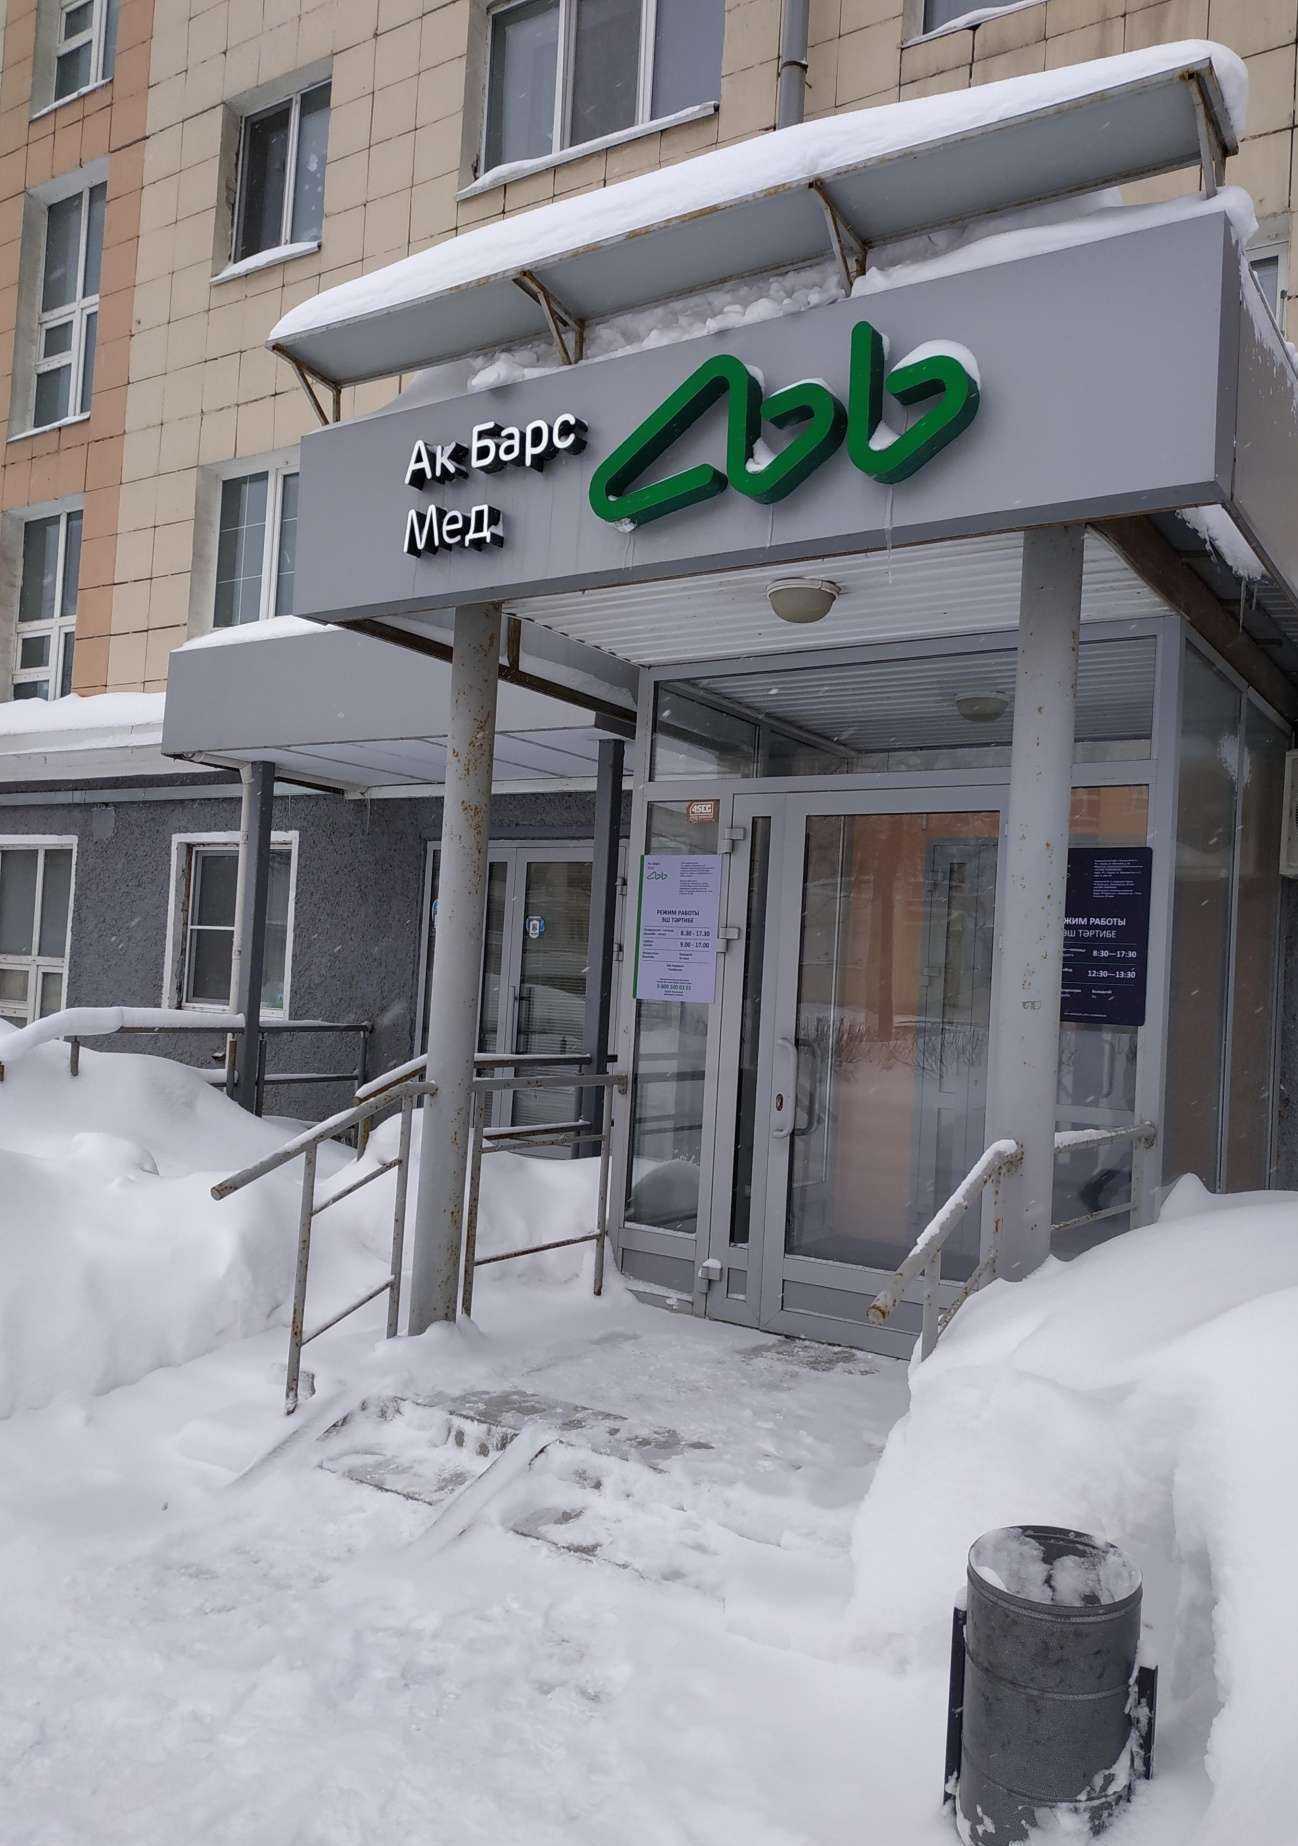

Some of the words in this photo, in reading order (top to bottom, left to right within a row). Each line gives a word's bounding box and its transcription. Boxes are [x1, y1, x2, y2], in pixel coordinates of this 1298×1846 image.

[405, 440, 456, 485] Ак
[471, 413, 576, 468] Барс
[404, 504, 491, 553] Мед
[1064, 917, 1088, 925] ЖИМ
[1090, 917, 1126, 926] РАБОТЫ
[1079, 930, 1117, 938] ТӘРТИБЕ
